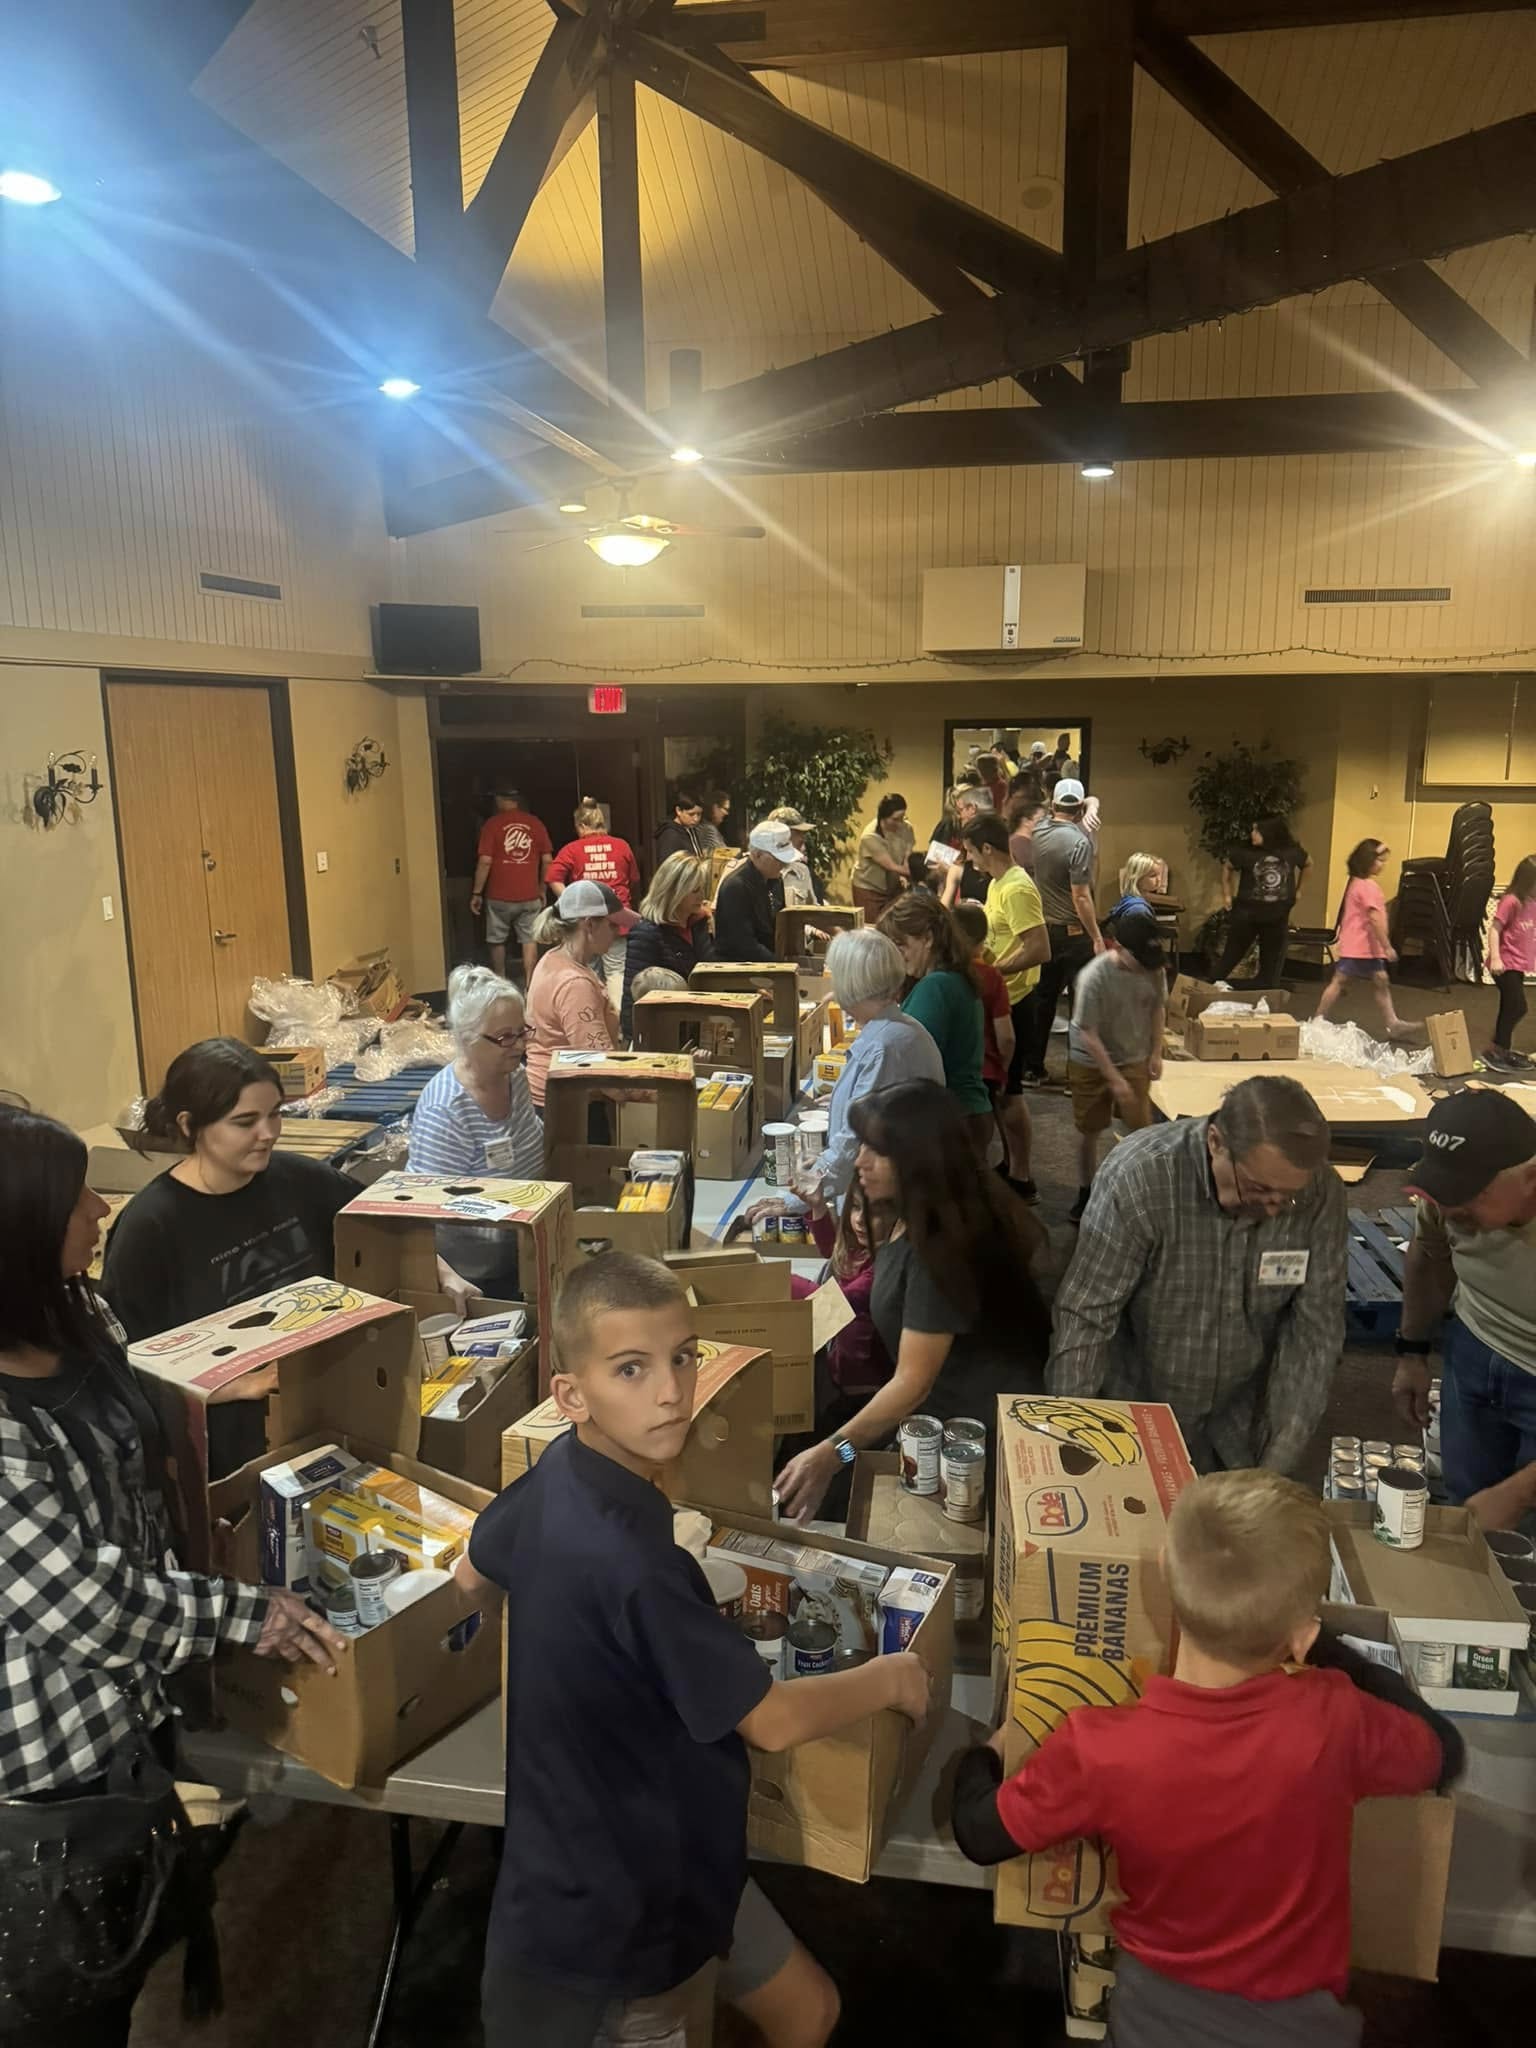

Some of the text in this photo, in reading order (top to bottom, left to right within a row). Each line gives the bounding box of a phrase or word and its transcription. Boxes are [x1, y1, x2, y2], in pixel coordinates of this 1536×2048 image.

[503, 829, 533, 854] Elks
[1429, 1130, 1466, 1151] 607
[1039, 1490, 1065, 1528] Dole
[749, 1583, 762, 1608] Oats
[1075, 1561, 1103, 1657] PREMIUM
[1102, 1563, 1129, 1661] BANANAS
[903, 1618, 912, 1643] WinCo
[1472, 1660, 1494, 1671] Beans
[1473, 1652, 1494, 1664] Green
